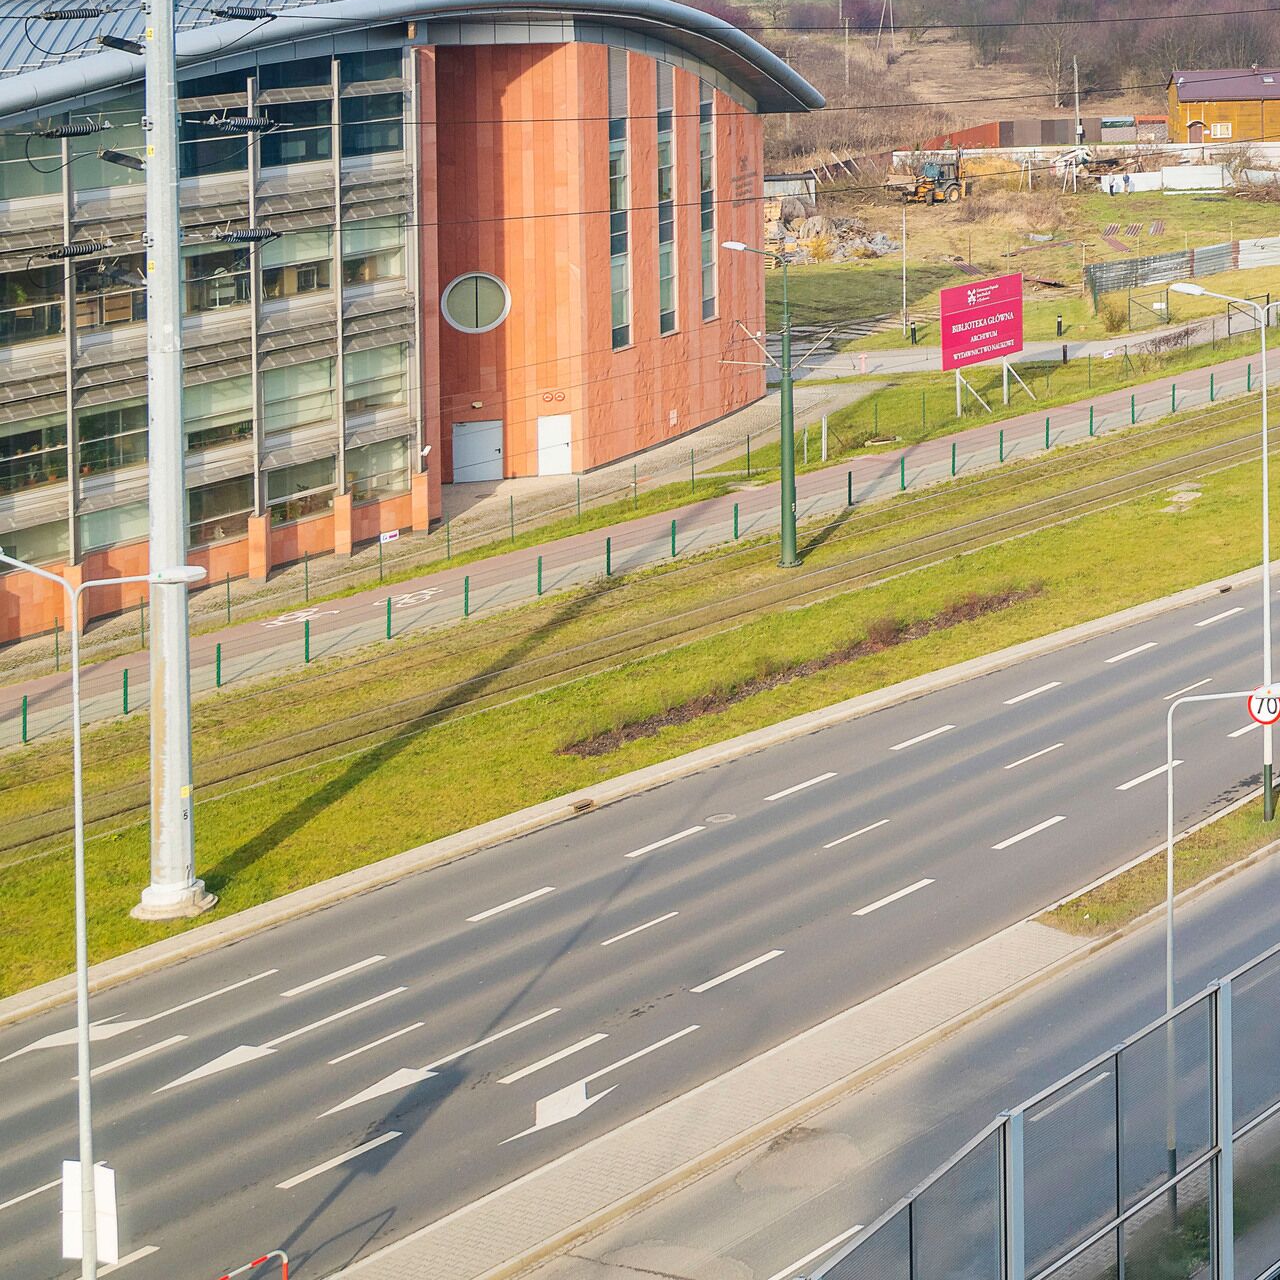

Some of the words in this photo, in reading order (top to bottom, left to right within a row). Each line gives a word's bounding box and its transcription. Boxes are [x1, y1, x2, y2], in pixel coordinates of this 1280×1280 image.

[951, 318, 988, 334] BIBLIOTEKA
[970, 329, 998, 343] ARCHIWUM
[953, 345, 992, 360] WYDAWNICTWO
[1255, 697, 1278, 715] 70
[184, 812, 188, 820] 5
